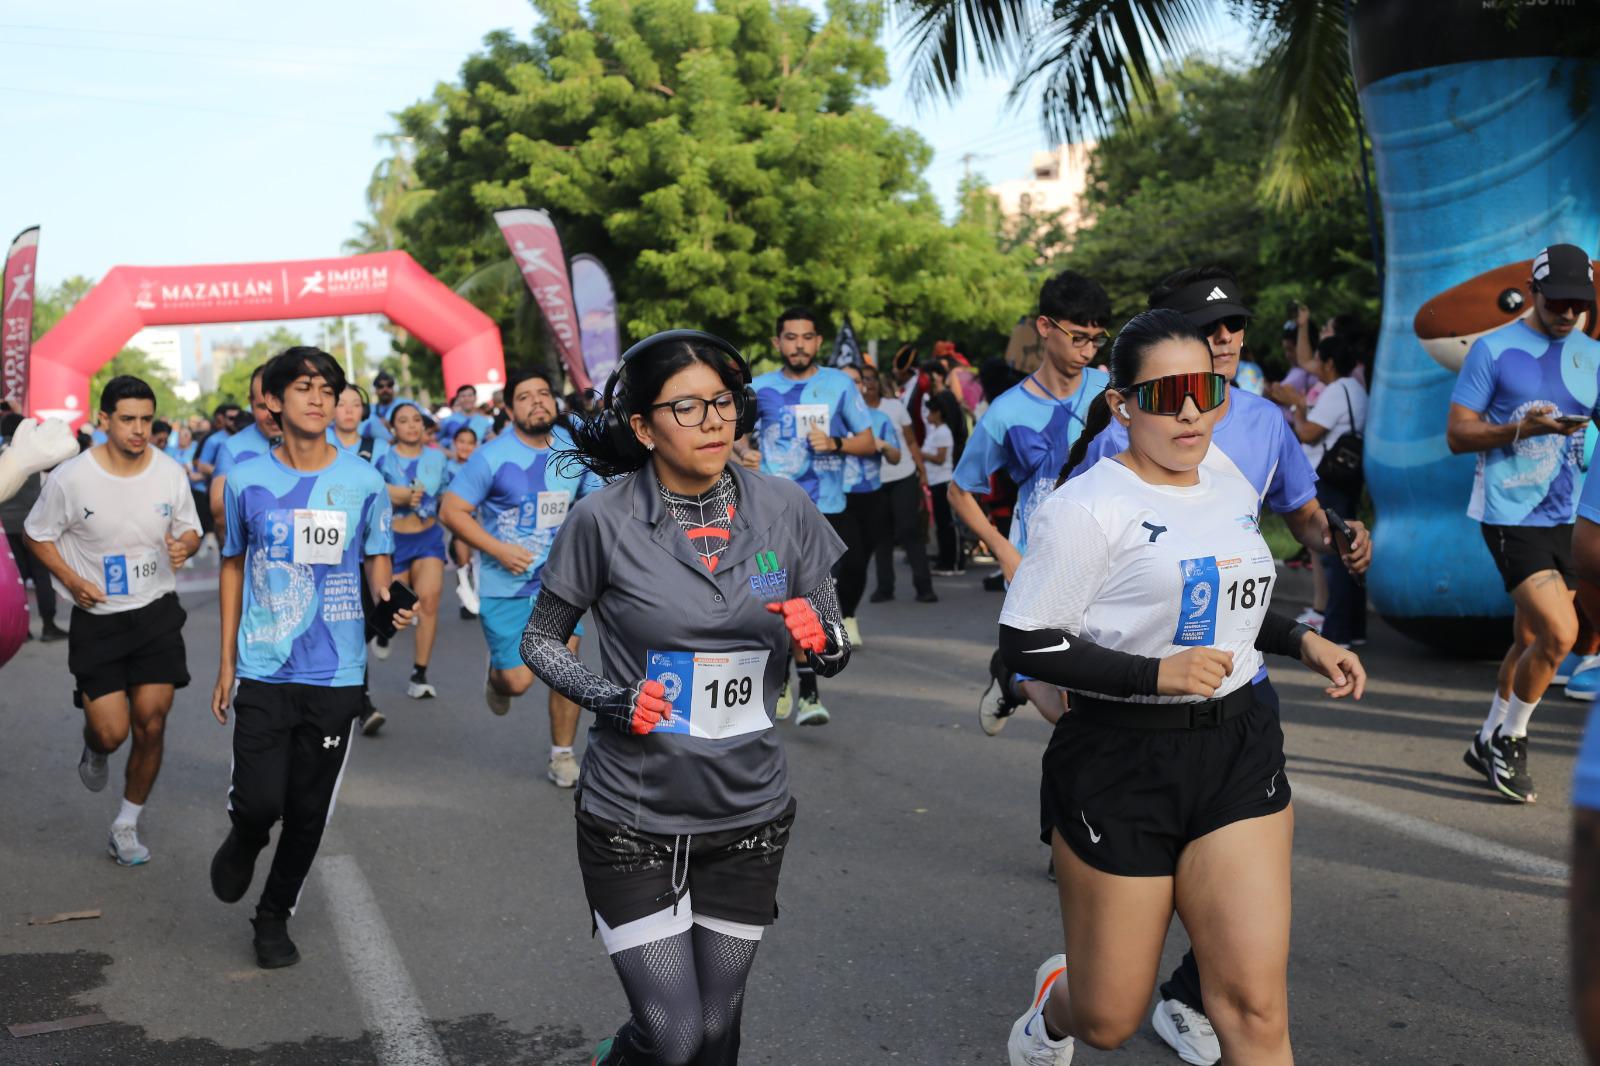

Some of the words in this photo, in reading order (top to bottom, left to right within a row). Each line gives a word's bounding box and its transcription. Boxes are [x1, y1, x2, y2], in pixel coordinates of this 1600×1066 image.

[161, 276, 273, 301] MAZATLÁN
[541, 502, 565, 515] 082
[271, 522, 288, 545] 9
[302, 526, 339, 545] 109
[133, 561, 157, 579] 189
[1189, 581, 1212, 620] 9
[1227, 575, 1272, 611] 187
[704, 676, 752, 709] 169
